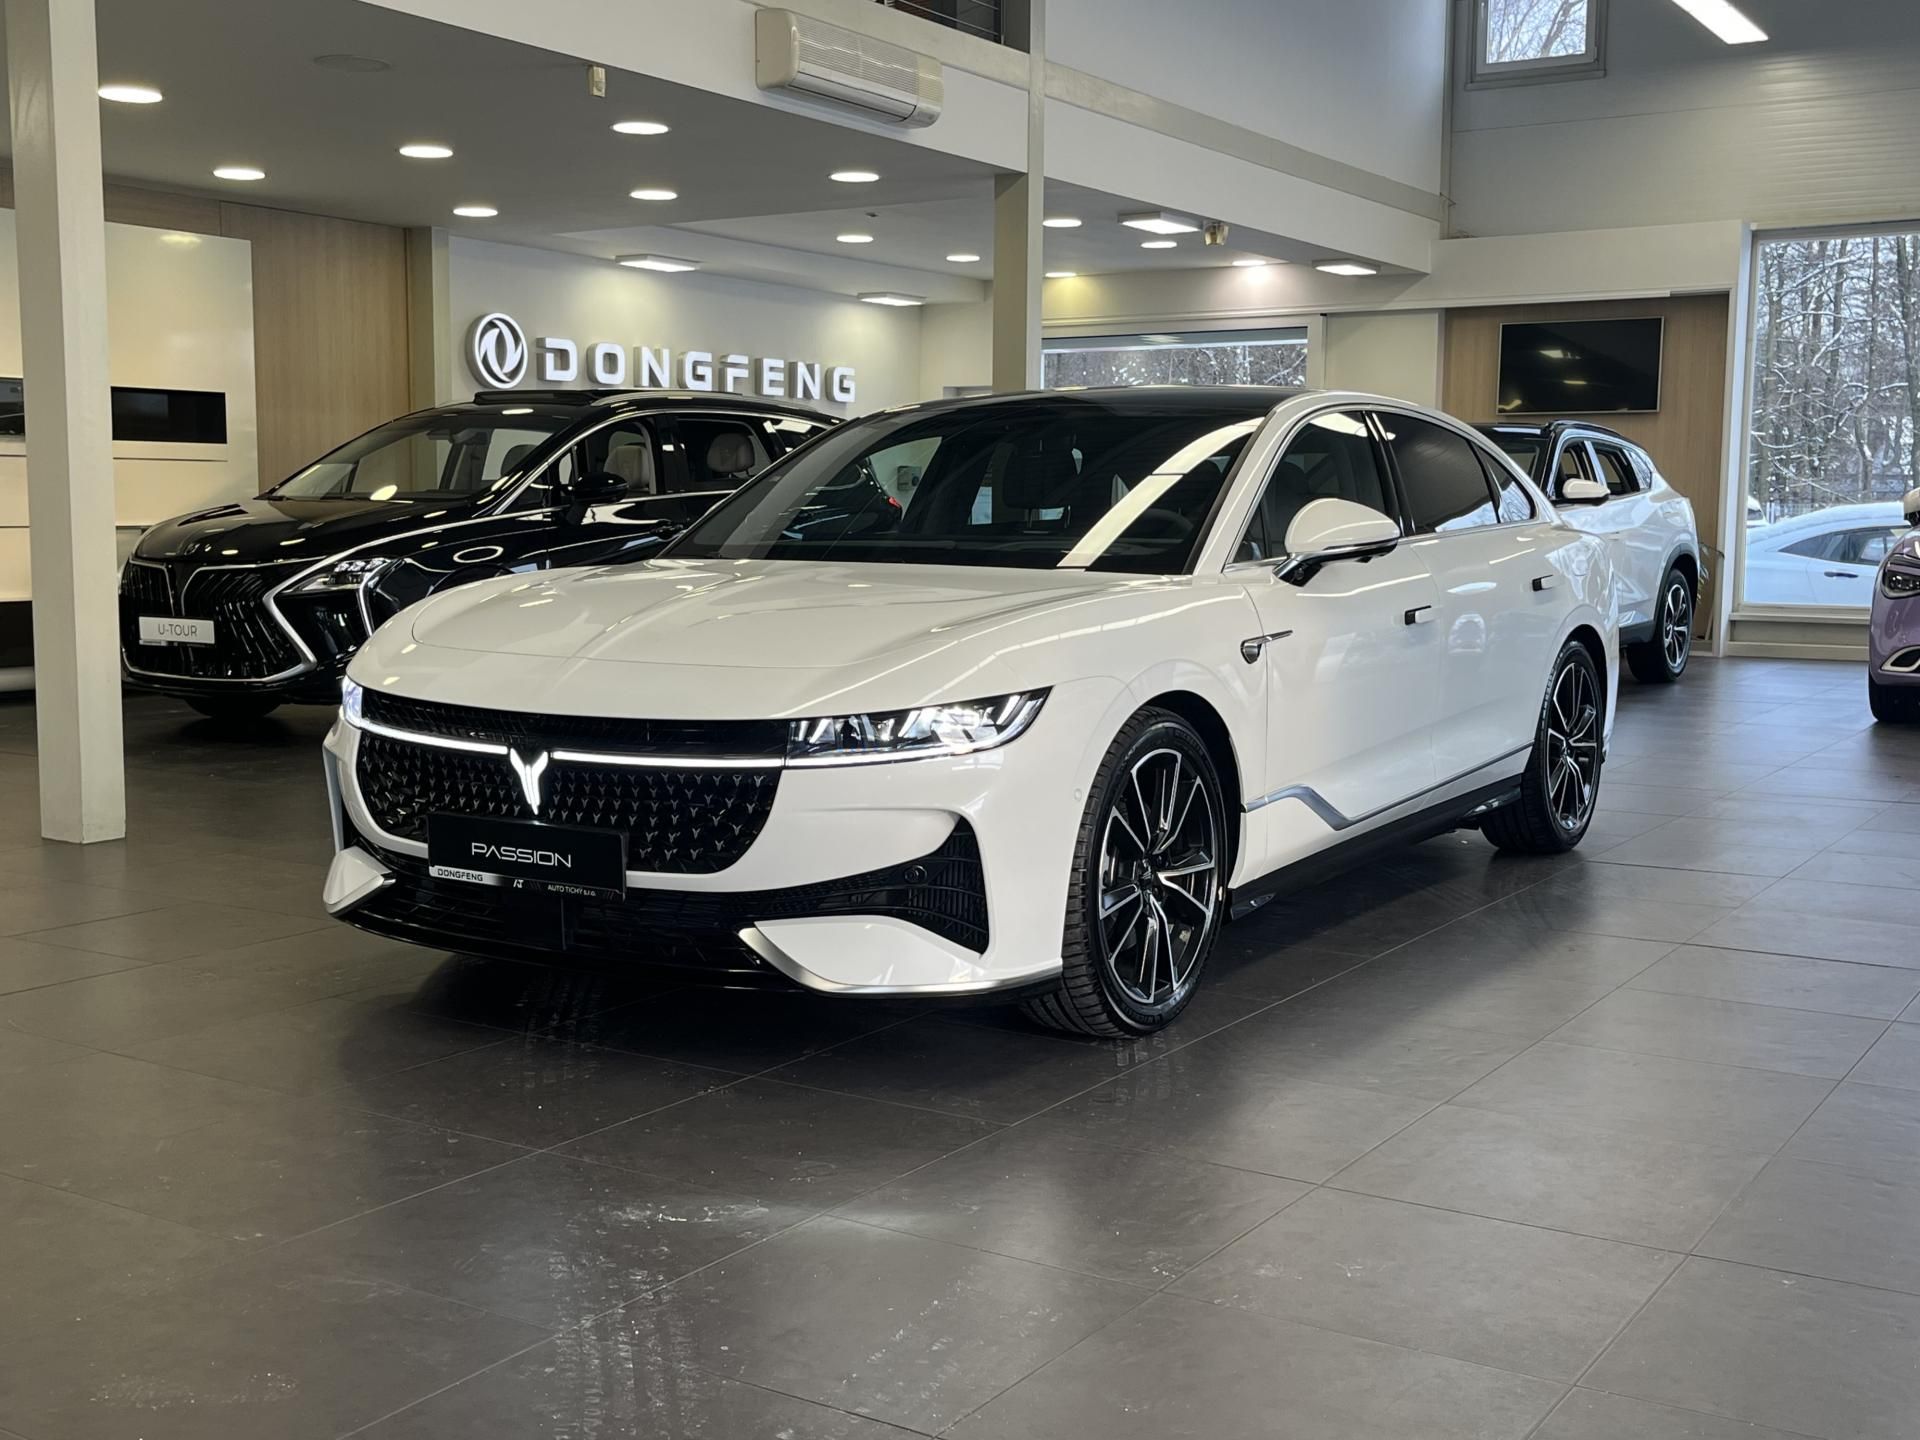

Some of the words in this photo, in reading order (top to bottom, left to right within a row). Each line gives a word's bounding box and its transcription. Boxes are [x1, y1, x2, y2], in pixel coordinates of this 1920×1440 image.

[536, 337, 856, 403] DONGFENG
[158, 623, 198, 637] U-TOUR
[471, 842, 572, 868] PASSION
[437, 868, 484, 882] DONGFENG
[547, 884, 565, 893] AUTO
